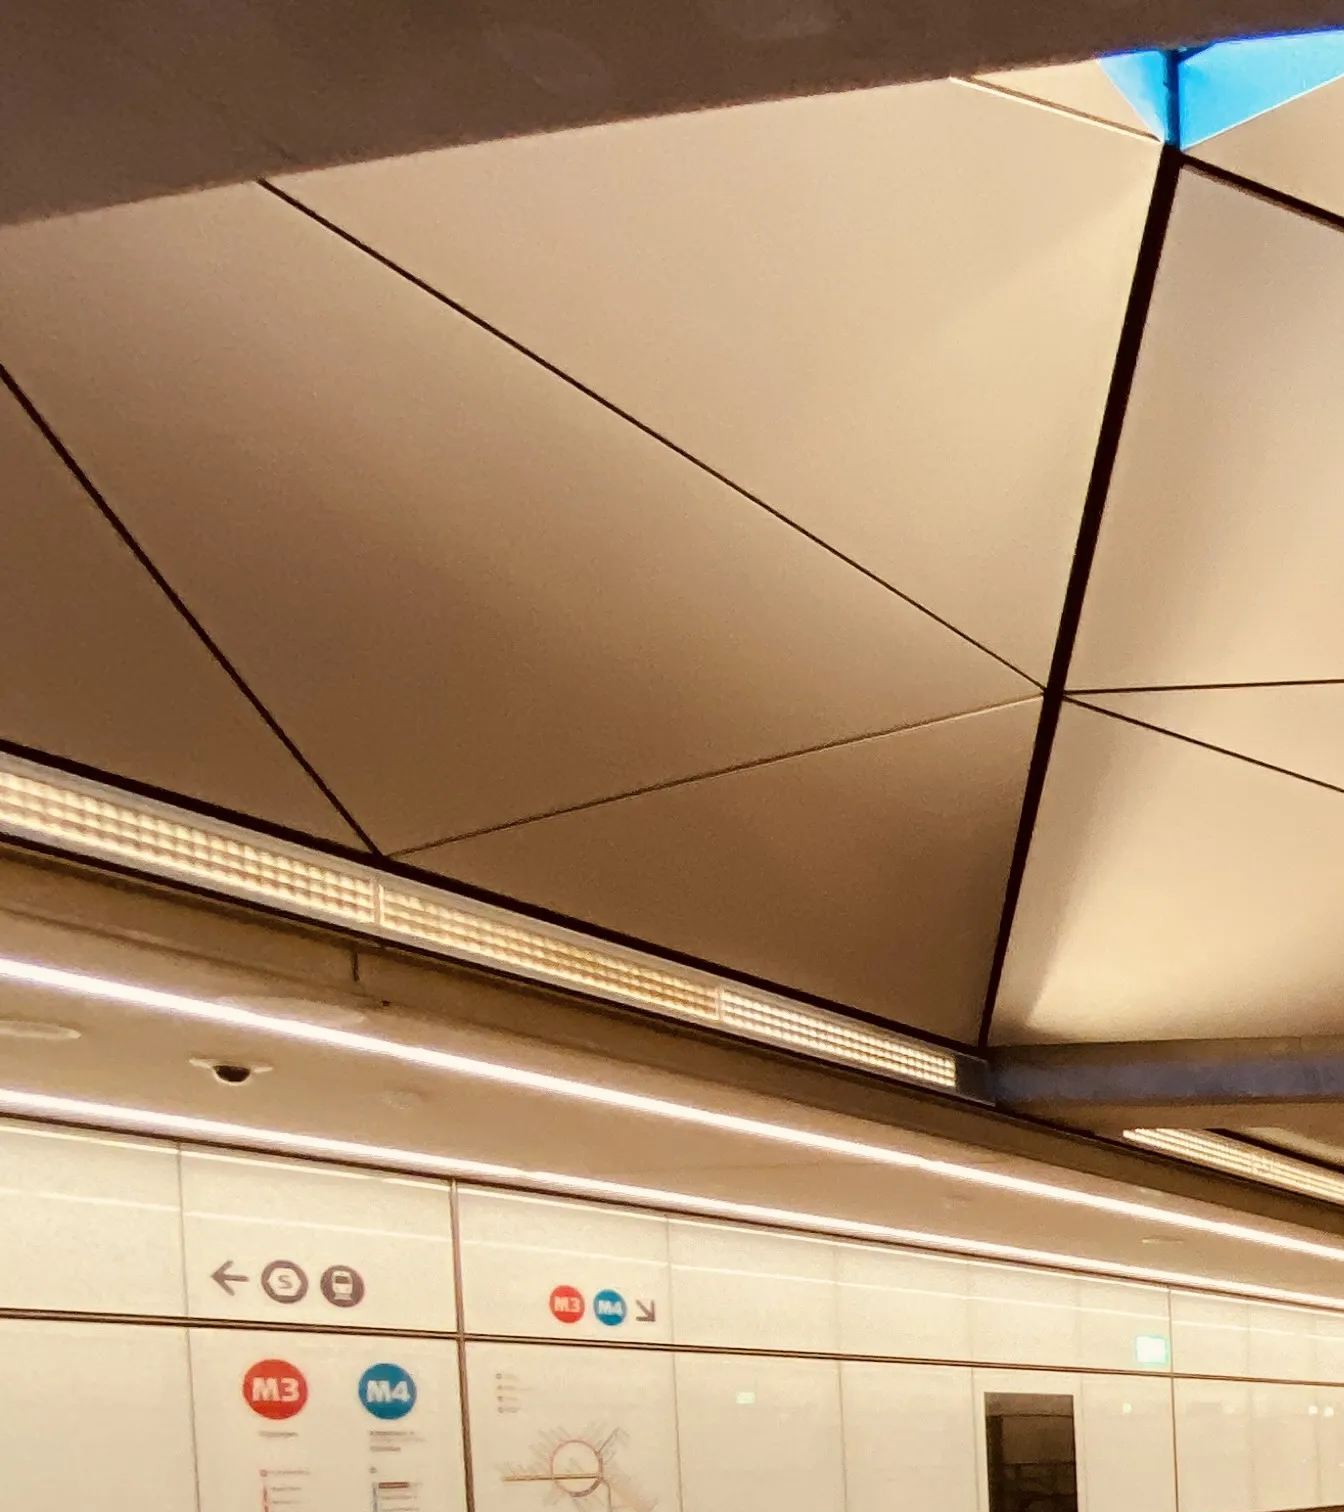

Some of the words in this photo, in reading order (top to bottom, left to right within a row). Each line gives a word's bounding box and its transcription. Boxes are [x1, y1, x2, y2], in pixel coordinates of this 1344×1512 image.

[554, 1296, 581, 1313] M3
[598, 1299, 623, 1316] M4
[252, 1377, 300, 1402] M3
[366, 1379, 411, 1403] M4
